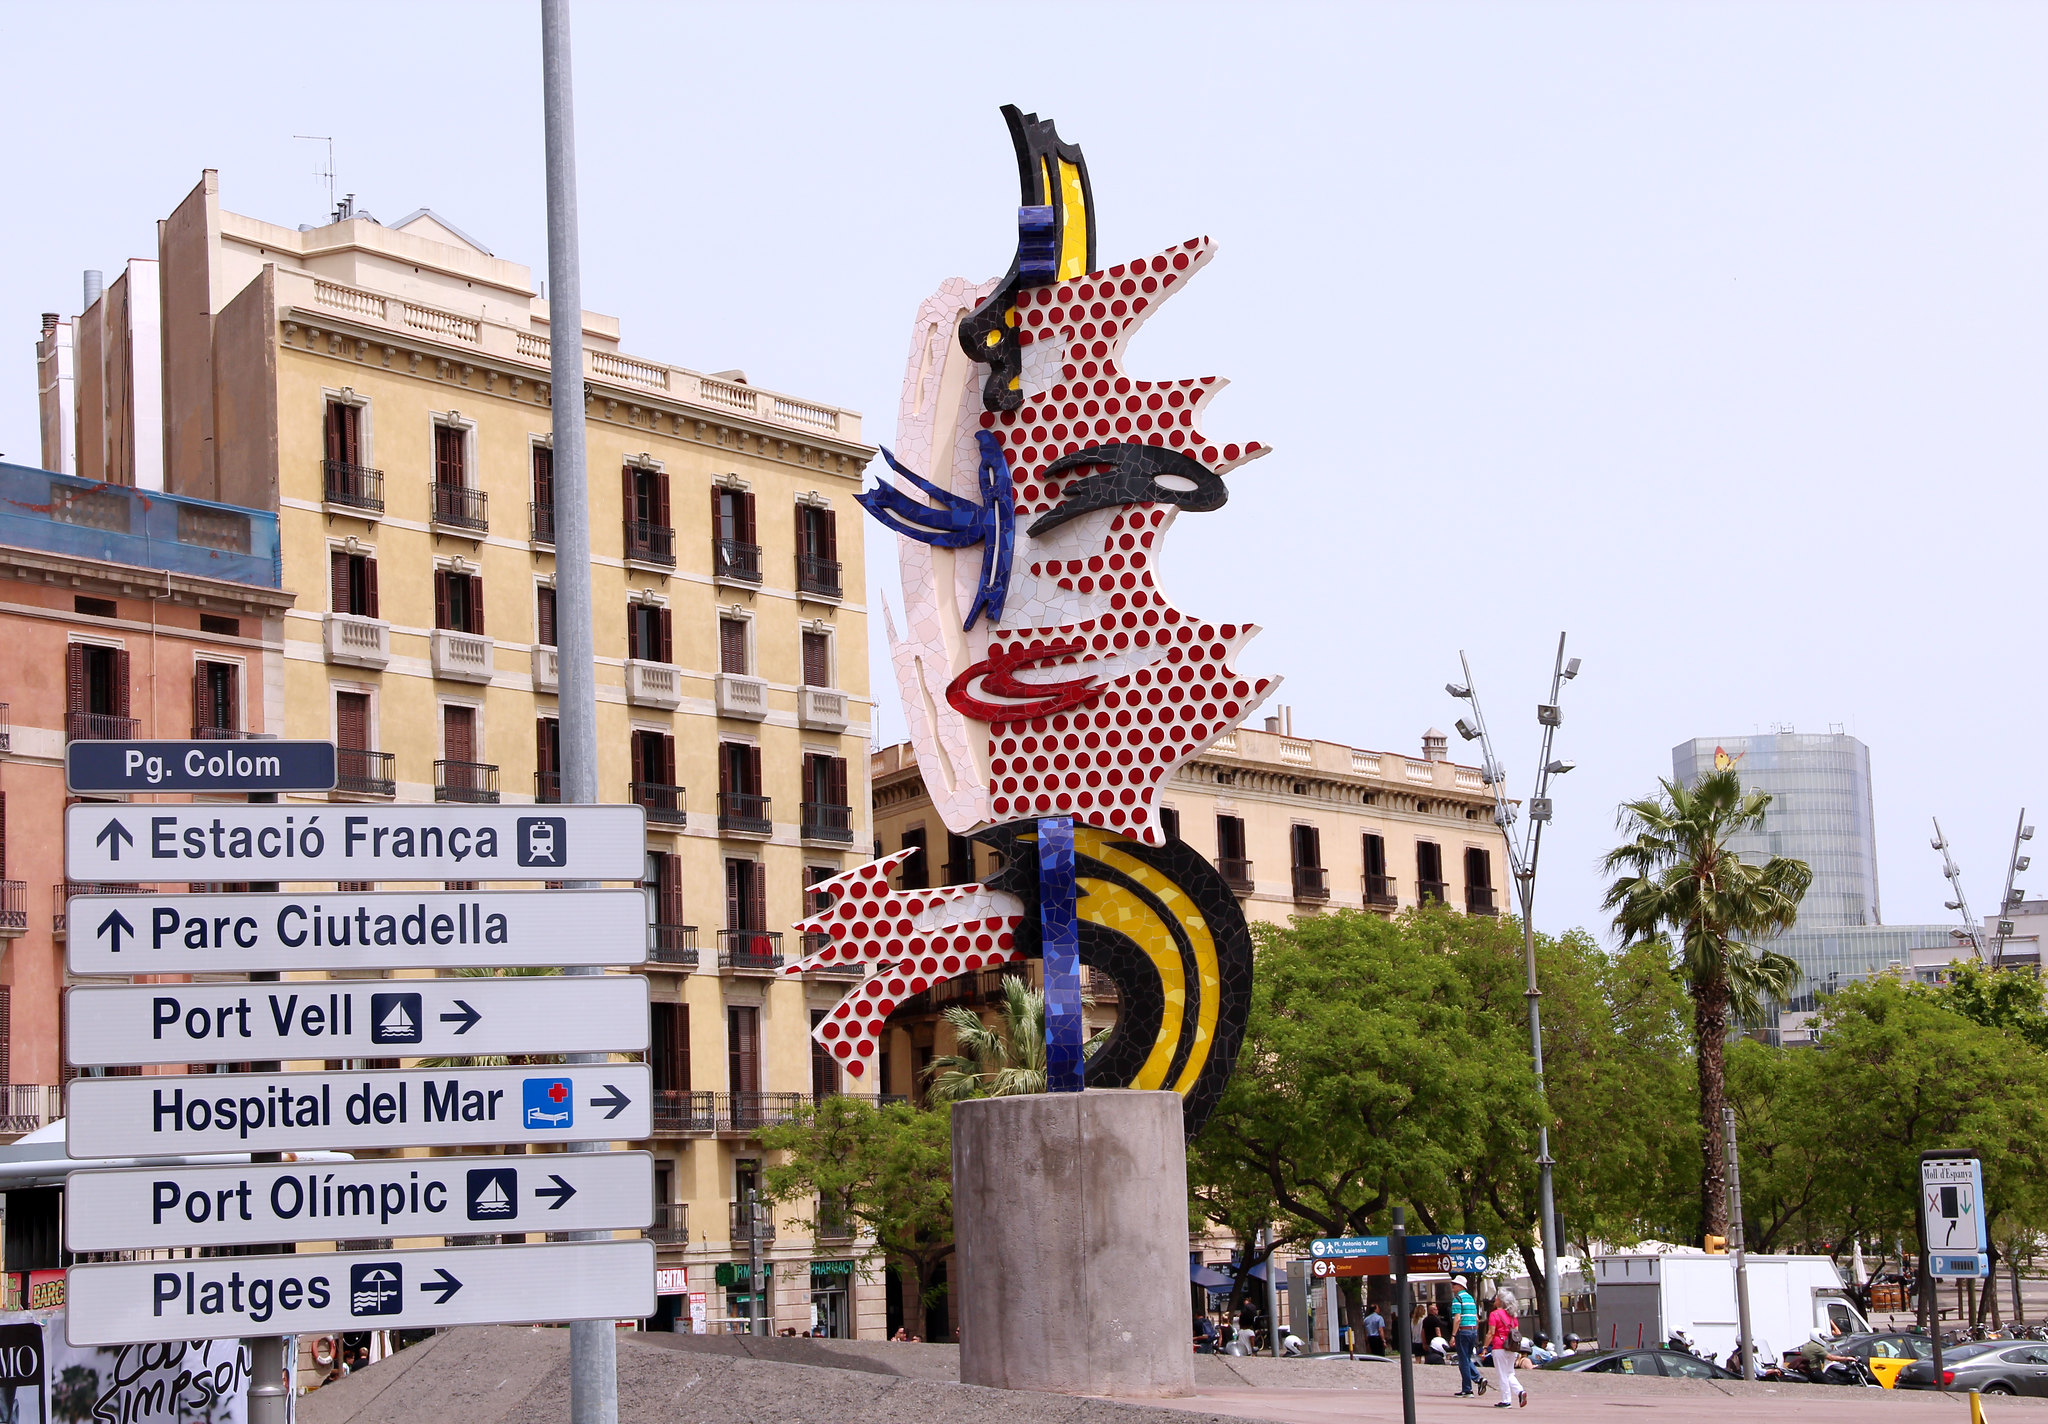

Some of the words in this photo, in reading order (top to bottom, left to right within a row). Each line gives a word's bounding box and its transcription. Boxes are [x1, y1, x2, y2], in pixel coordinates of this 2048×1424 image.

[126, 750, 172, 783] Pg.
[184, 750, 280, 777] Colom
[152, 815, 325, 859] Estació
[345, 816, 498, 862] França
[152, 907, 258, 950] Parc
[277, 903, 508, 947] Ciutadella
[153, 997, 251, 1040] Port
[269, 994, 352, 1037] Vell
[153, 1084, 330, 1139] Hospital
[346, 1081, 407, 1125] del
[424, 1080, 504, 1122] Mar
[1924, 1168, 1938, 1180] Moll
[1940, 1167, 1973, 1182] d'Espanya
[153, 1180, 252, 1225] Port
[270, 1171, 448, 1224] Olímpic
[656, 1269, 686, 1289] RENTAL
[810, 1261, 854, 1275] PHARMACY
[33, 1279, 66, 1310] BARC
[153, 1272, 331, 1323] Platges
